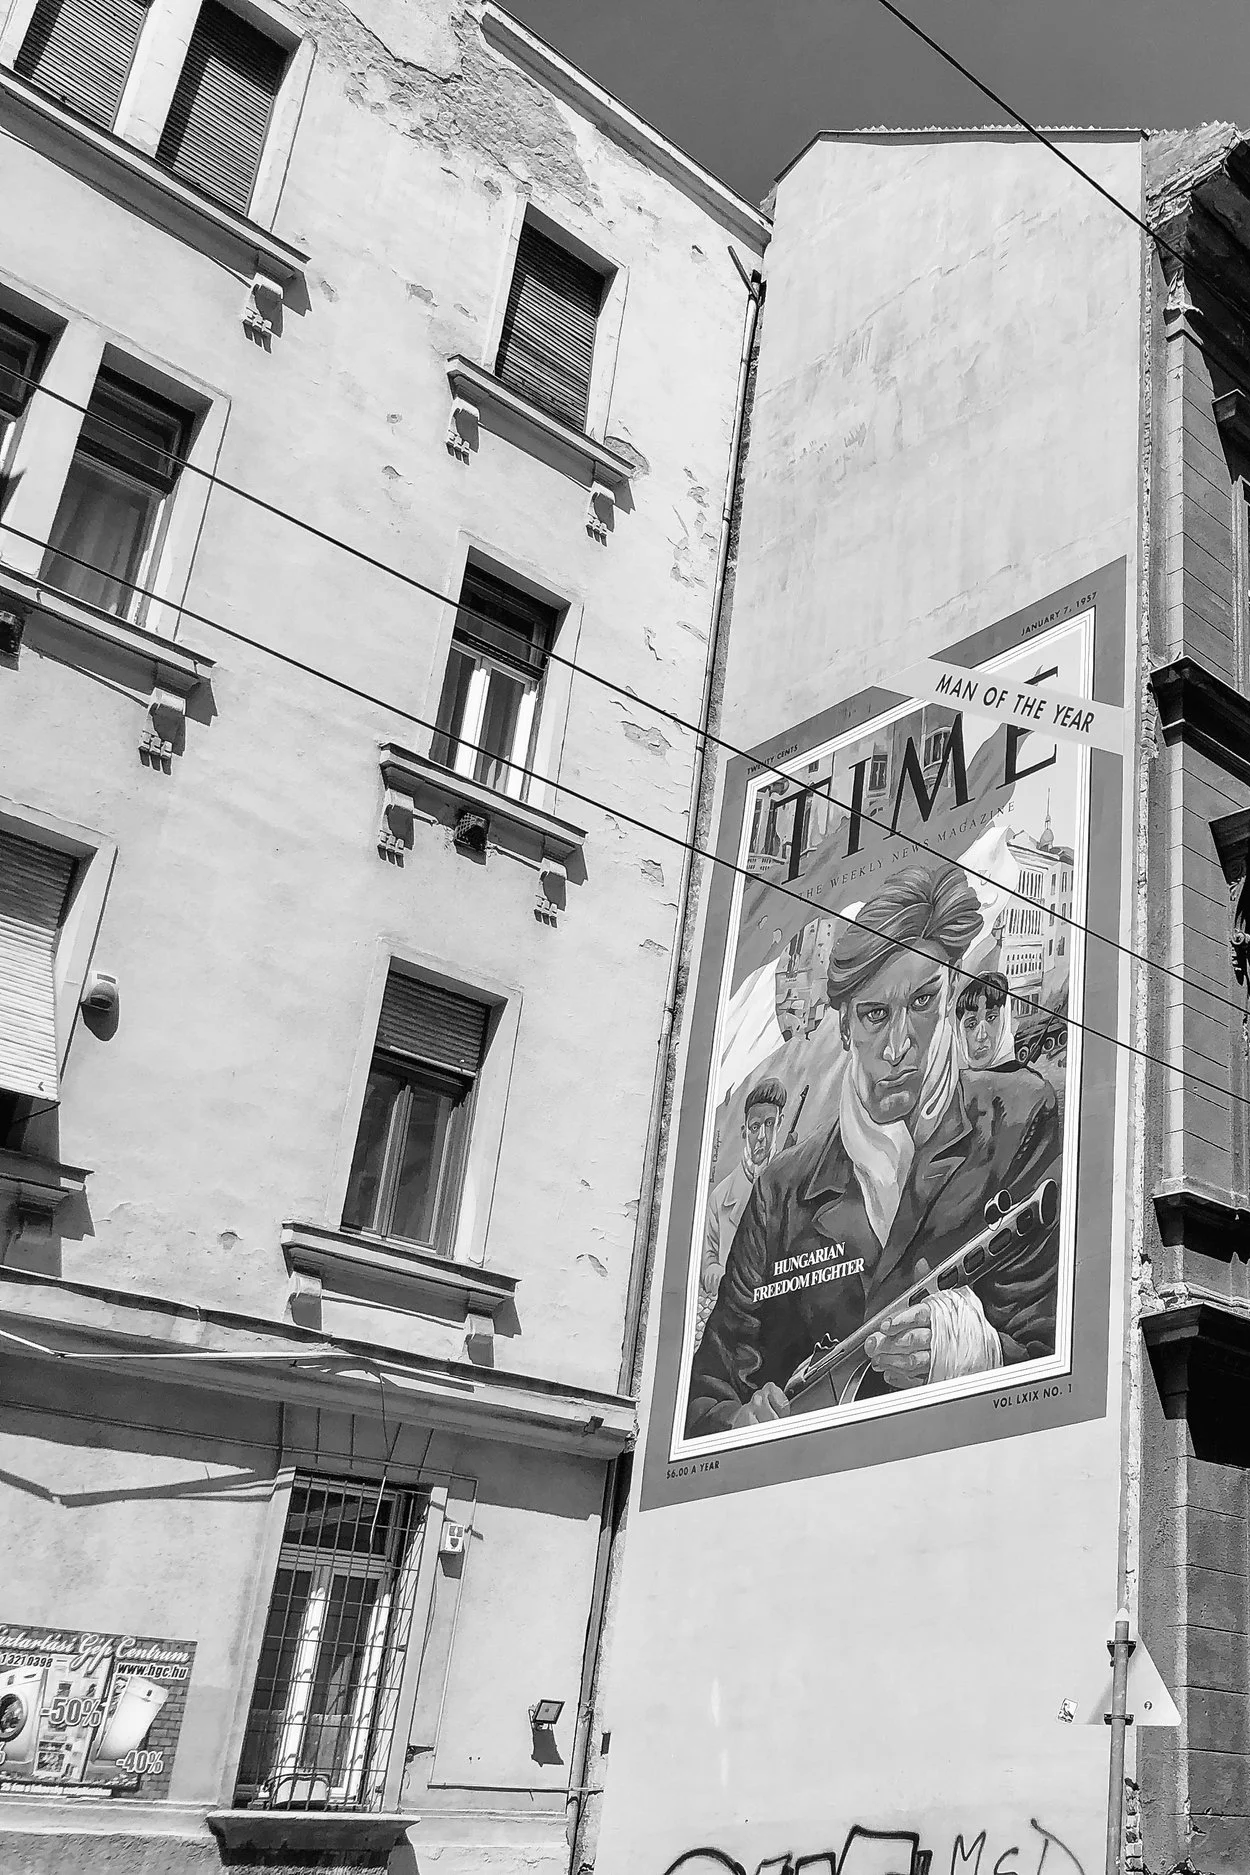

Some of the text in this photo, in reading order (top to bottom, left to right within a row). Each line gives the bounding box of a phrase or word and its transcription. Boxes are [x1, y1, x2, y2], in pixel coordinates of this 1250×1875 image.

[1020, 591, 1097, 637] JANUARY 7, 1957
[935, 673, 1096, 734] MAN OF THE YEAR
[776, 744, 798, 760] CENTS
[773, 665, 1060, 886] TIME
[829, 859, 884, 889] WEEKLY
[891, 838, 930, 864] NEWS
[936, 802, 1016, 843] MAGAZINE
[773, 1241, 846, 1277] HUNGARIAN
[752, 1257, 865, 1303] FREEDOM FIGHTER
[993, 1396, 1013, 1409] VOL
[1016, 1390, 1039, 1404] LXIX
[1043, 1386, 1063, 1399] NO.
[666, 1460, 720, 1479] $6.00 A YEAR
[115, 1635, 190, 1663] Centrum
[117, 1663, 188, 1679] www.hgc.hu
[41, 1698, 101, 1727] -50%
[116, 1750, 164, 1775] -40%
